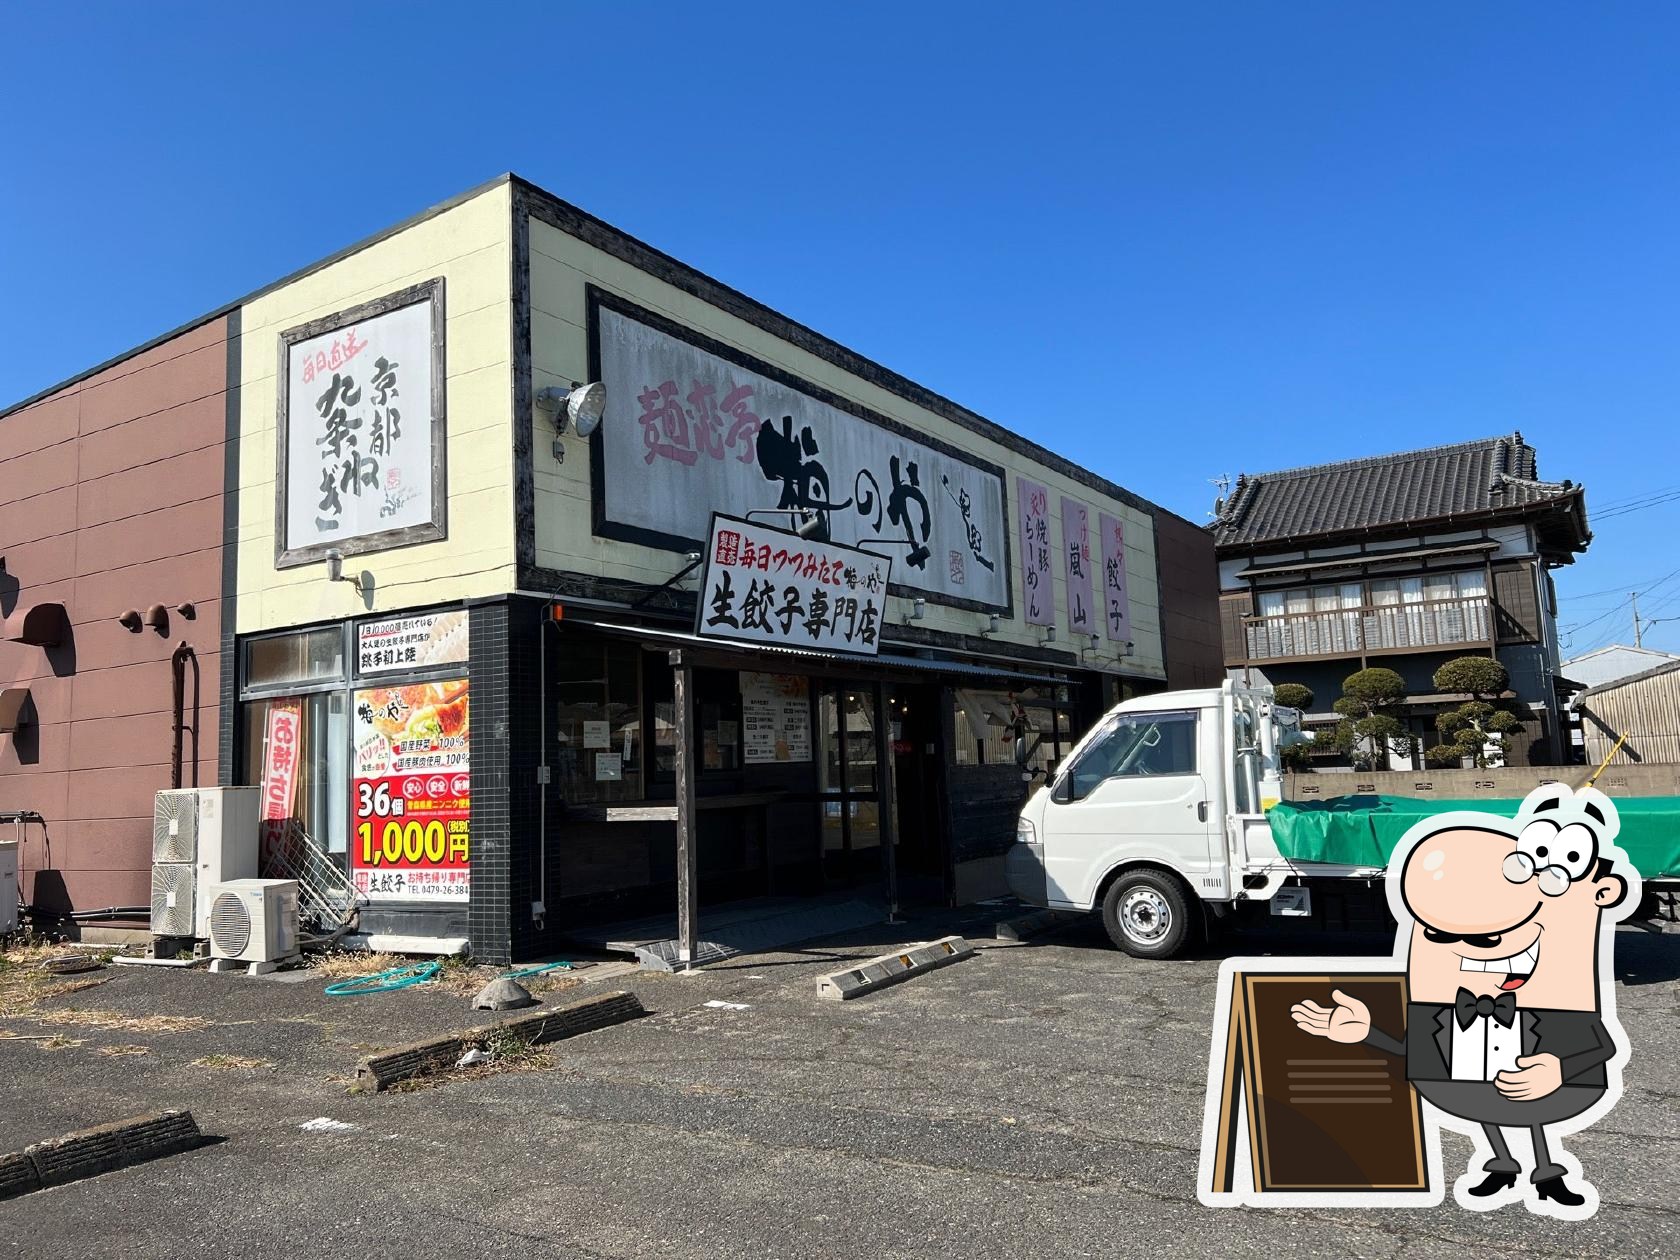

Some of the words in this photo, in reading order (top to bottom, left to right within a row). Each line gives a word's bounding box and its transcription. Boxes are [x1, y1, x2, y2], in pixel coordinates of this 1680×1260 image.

[302, 328, 368, 384] 毎日直送
[369, 356, 401, 456] 京都
[315, 373, 379, 532] 九条ねぎ
[739, 536, 844, 586] 毎日つつみたて
[1026, 514, 1040, 618] らーめん
[1070, 542, 1087, 625] 嵐山
[706, 570, 879, 646] 生餃子専門店
[1107, 557, 1123, 632] 餃子
[400, 739, 431, 752] 国産野菜
[440, 736, 464, 748] 100%
[358, 782, 404, 817] 36個
[406, 781, 422, 794] 安心
[430, 780, 446, 792] 安全
[358, 820, 469, 866] 1,000円
[369, 872, 405, 893] 生餃子
[408, 886, 420, 894] TEL
